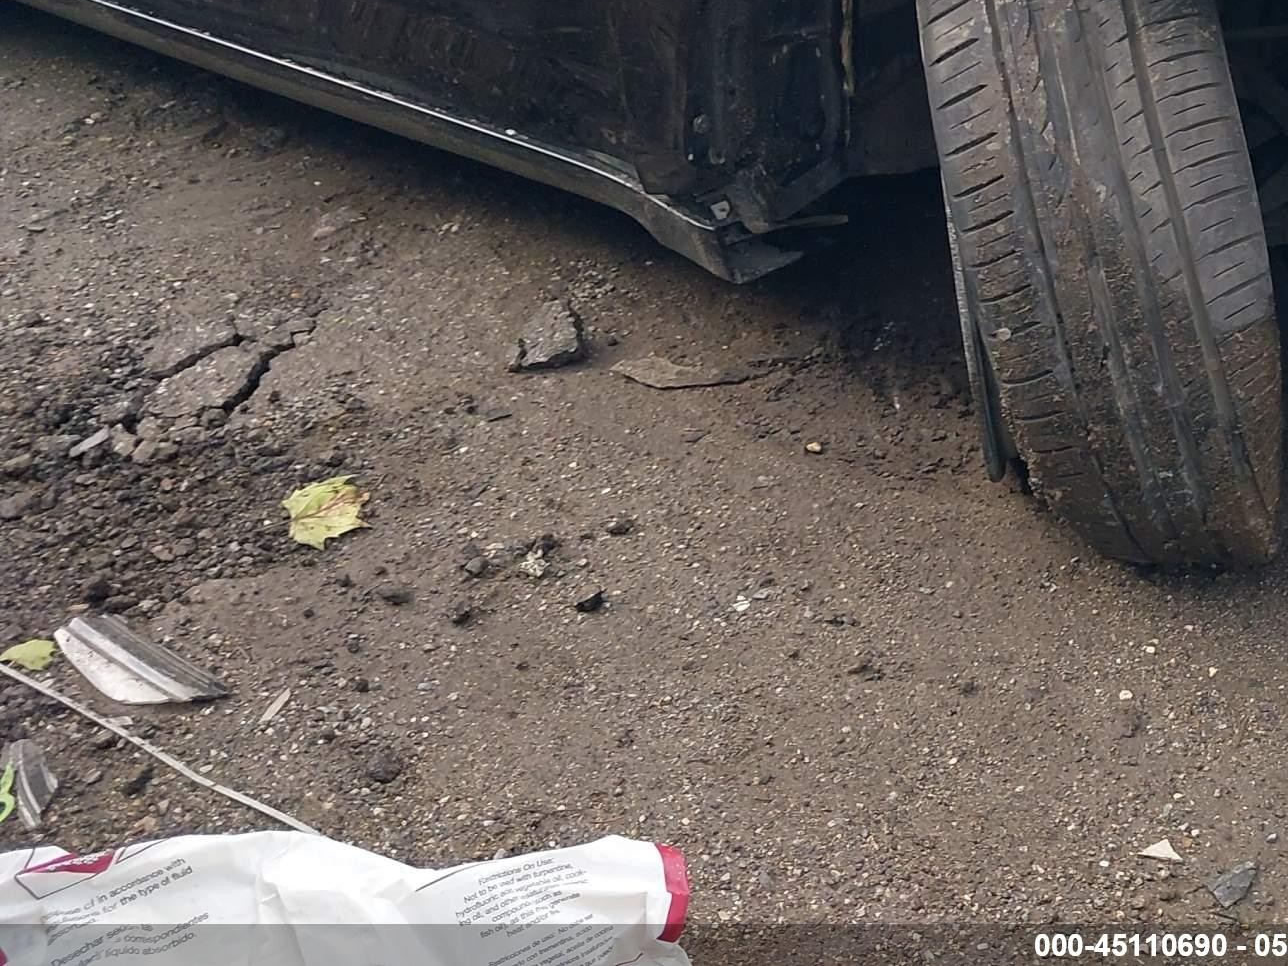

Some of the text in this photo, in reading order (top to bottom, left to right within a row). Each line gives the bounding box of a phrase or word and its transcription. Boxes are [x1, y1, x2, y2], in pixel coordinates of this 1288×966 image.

[110, 870, 164, 897] accordance
[164, 858, 186, 872] with
[119, 894, 138, 906] the
[138, 882, 160, 897] type
[171, 865, 193, 880] fluid
